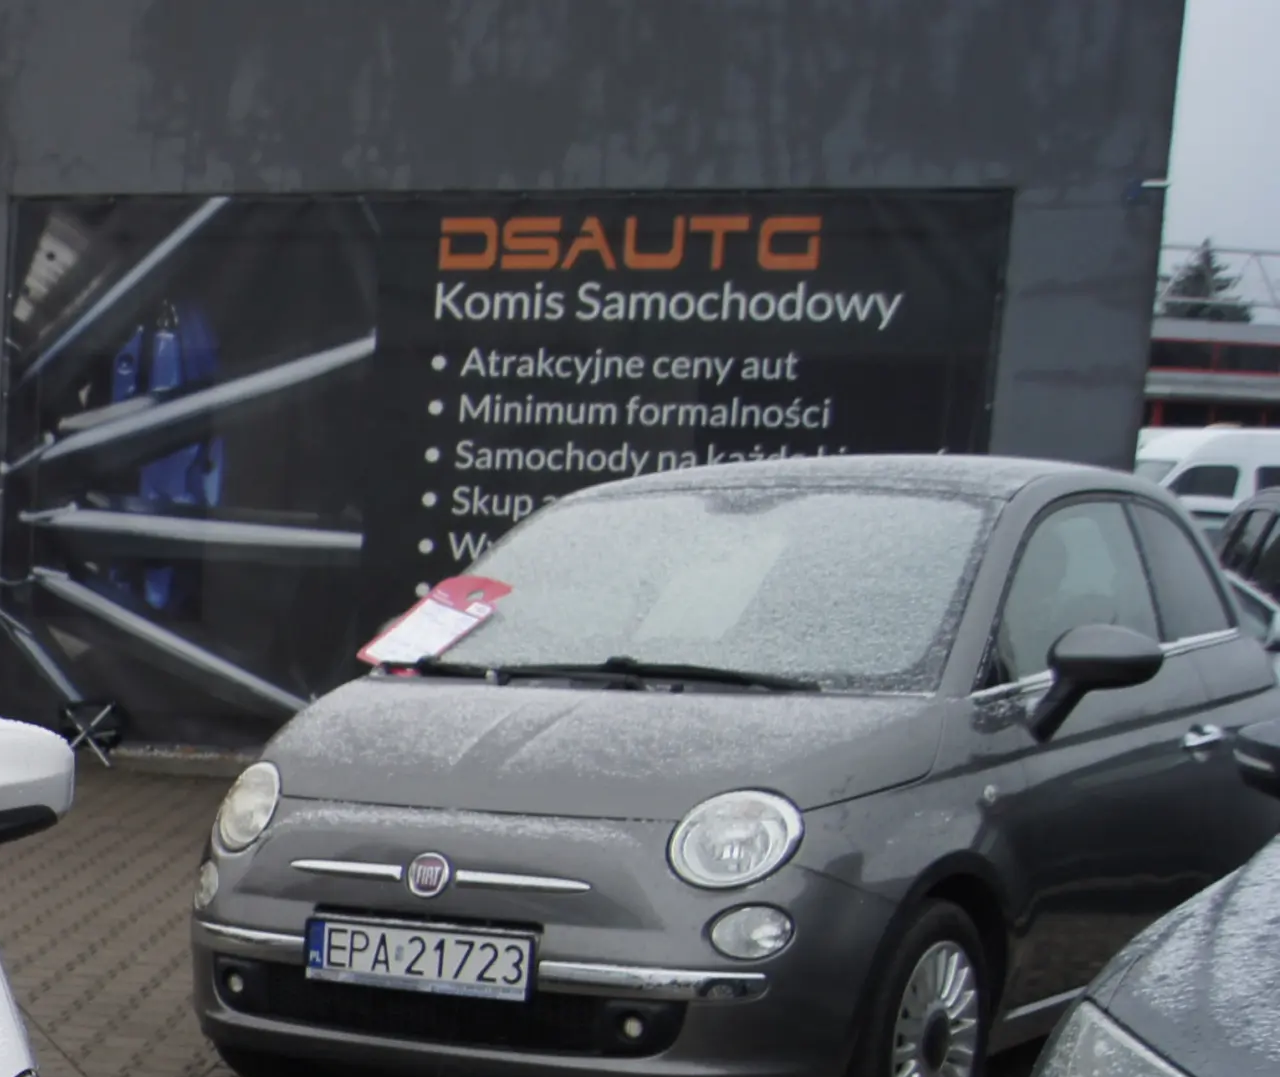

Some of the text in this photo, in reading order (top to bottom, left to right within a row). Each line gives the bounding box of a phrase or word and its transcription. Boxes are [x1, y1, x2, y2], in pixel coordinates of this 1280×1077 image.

[438, 215, 822, 271] DSAUTO
[433, 280, 903, 331] Komis Samochodowy
[459, 347, 799, 386] Atrakcyjne ceny aut
[458, 393, 832, 430] Minimum formalności
[453, 439, 650, 478] Samochody
[656, 450, 697, 473] na
[450, 484, 534, 523] Skup
[326, 928, 390, 974] EPA
[404, 935, 525, 985] 21723
